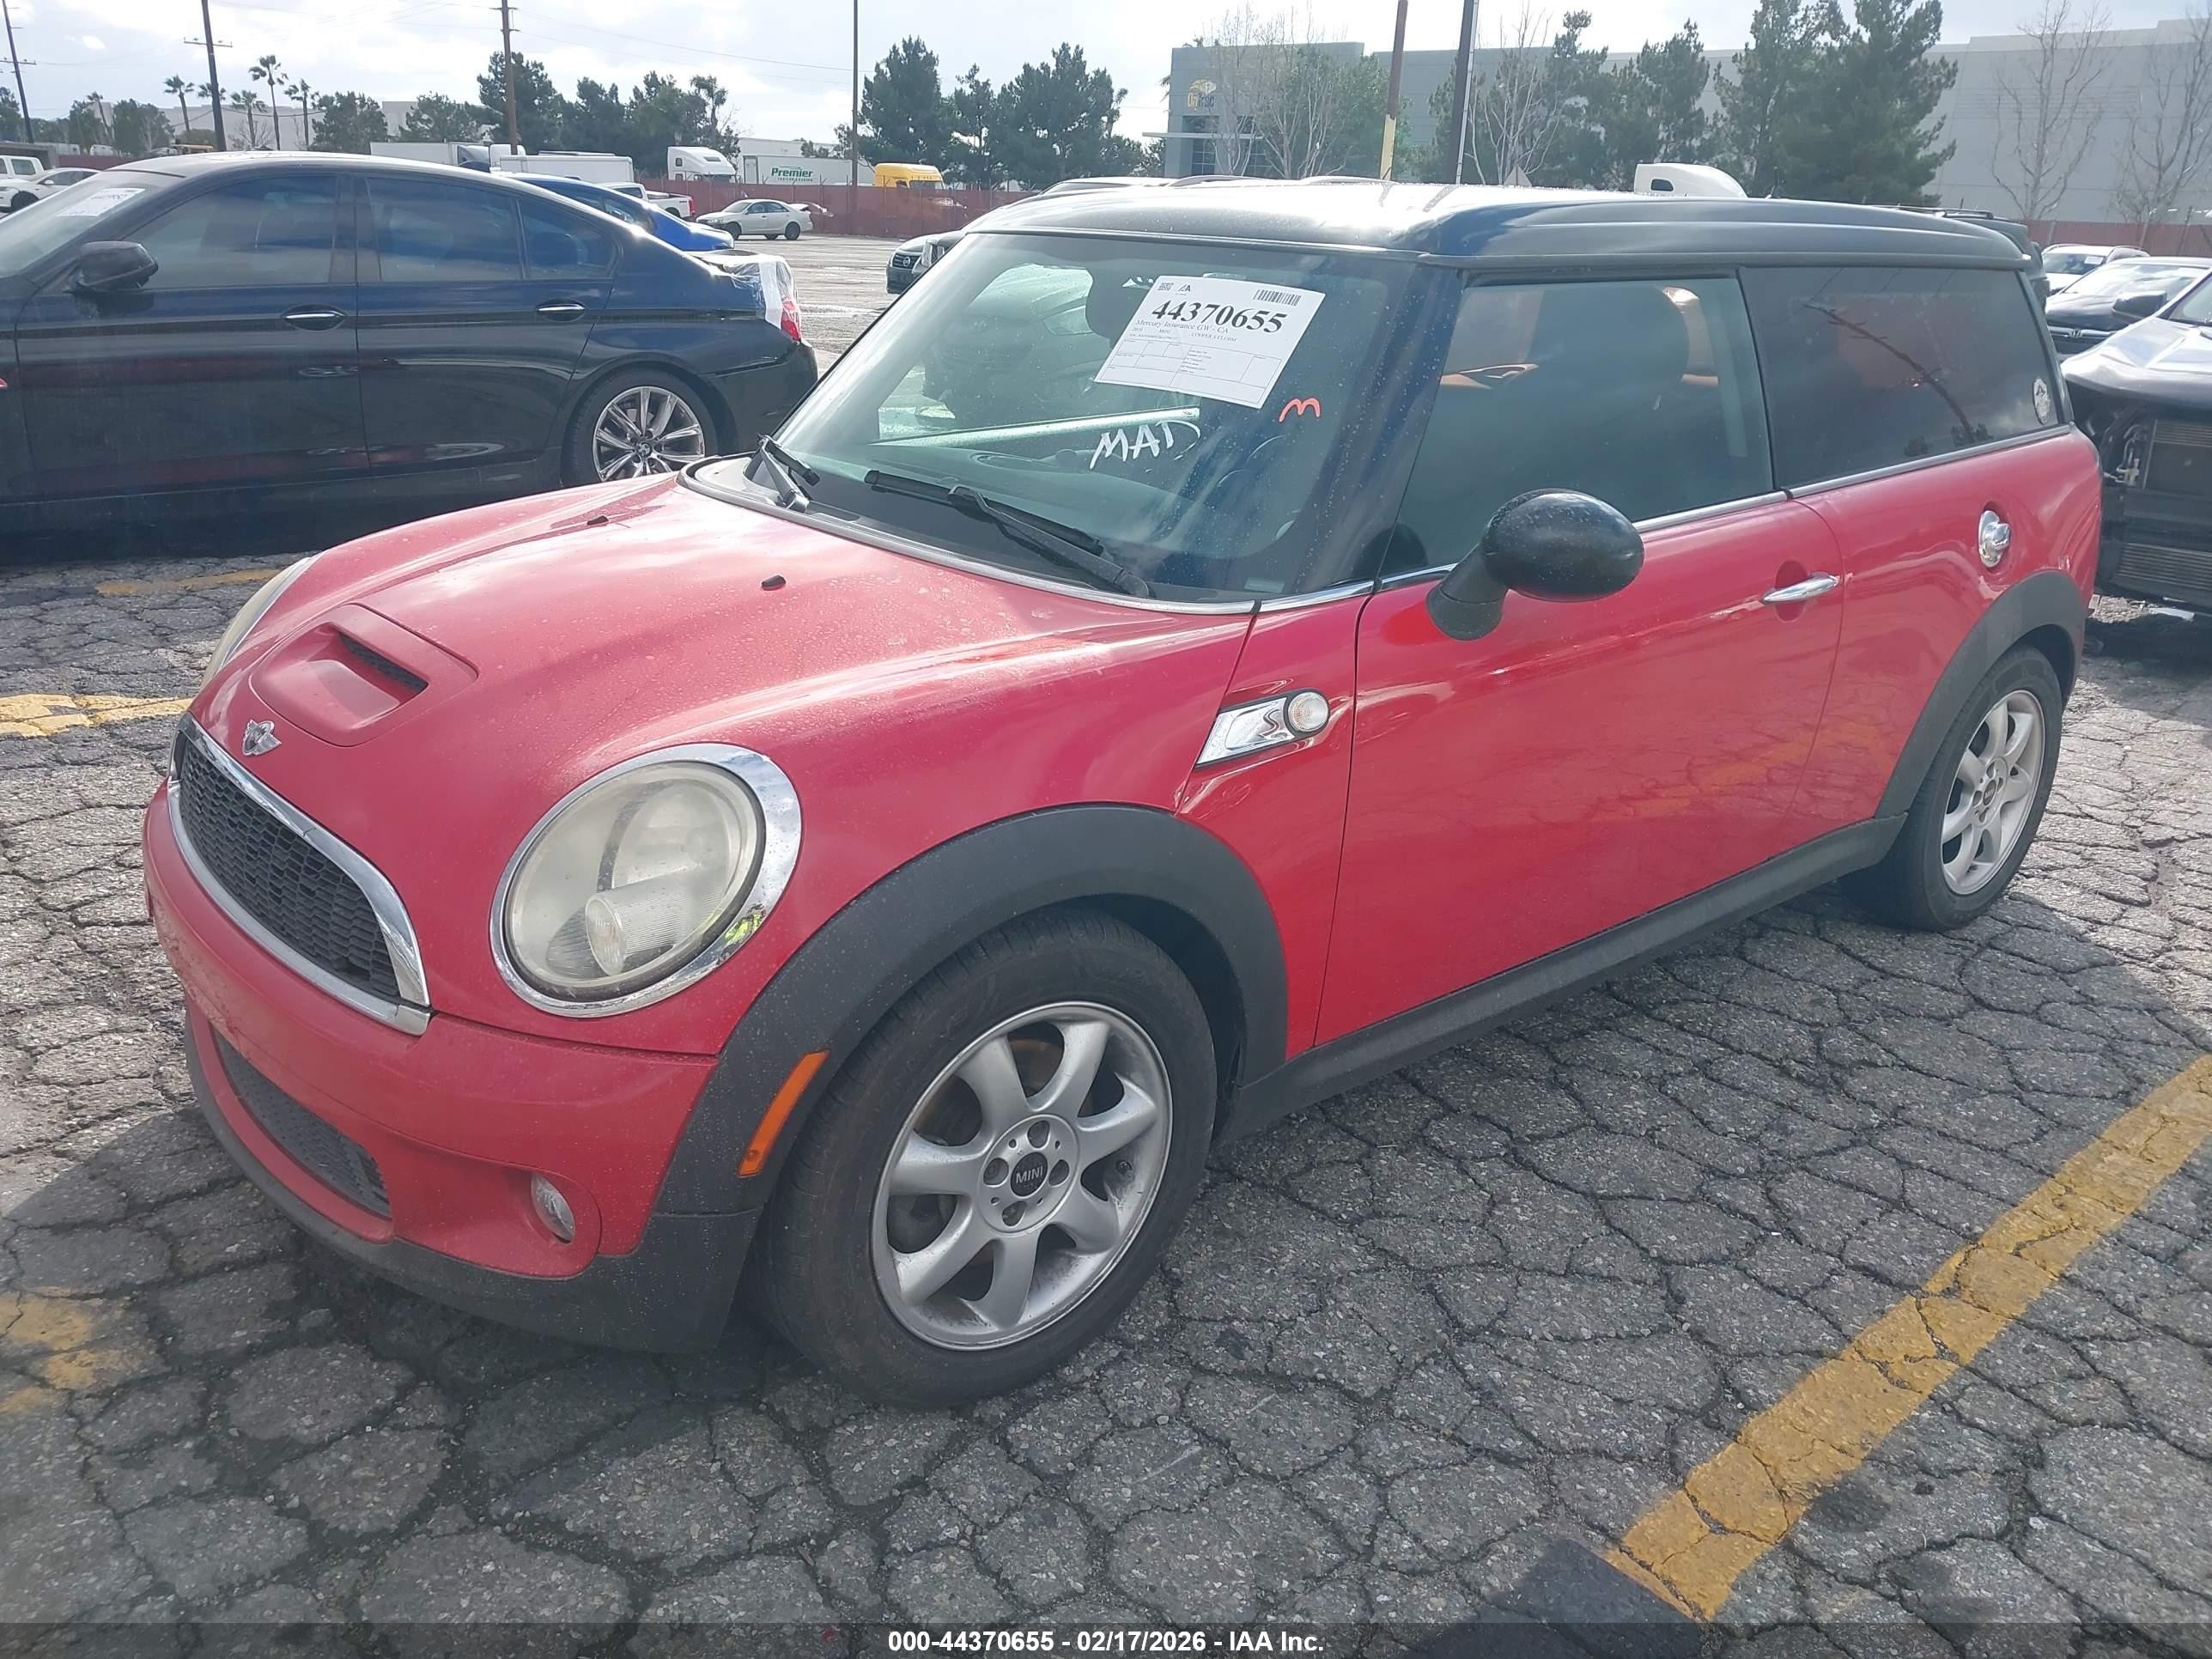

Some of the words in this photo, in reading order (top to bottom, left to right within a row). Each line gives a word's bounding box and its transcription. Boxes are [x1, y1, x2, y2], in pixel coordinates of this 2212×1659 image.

[771, 167, 813, 178] Premier
[1152, 300, 1288, 333] 44370655
[1164, 321, 1196, 330] Insurance
[1089, 420, 1200, 470] MAD
[1016, 1165, 1043, 1183] MINI
